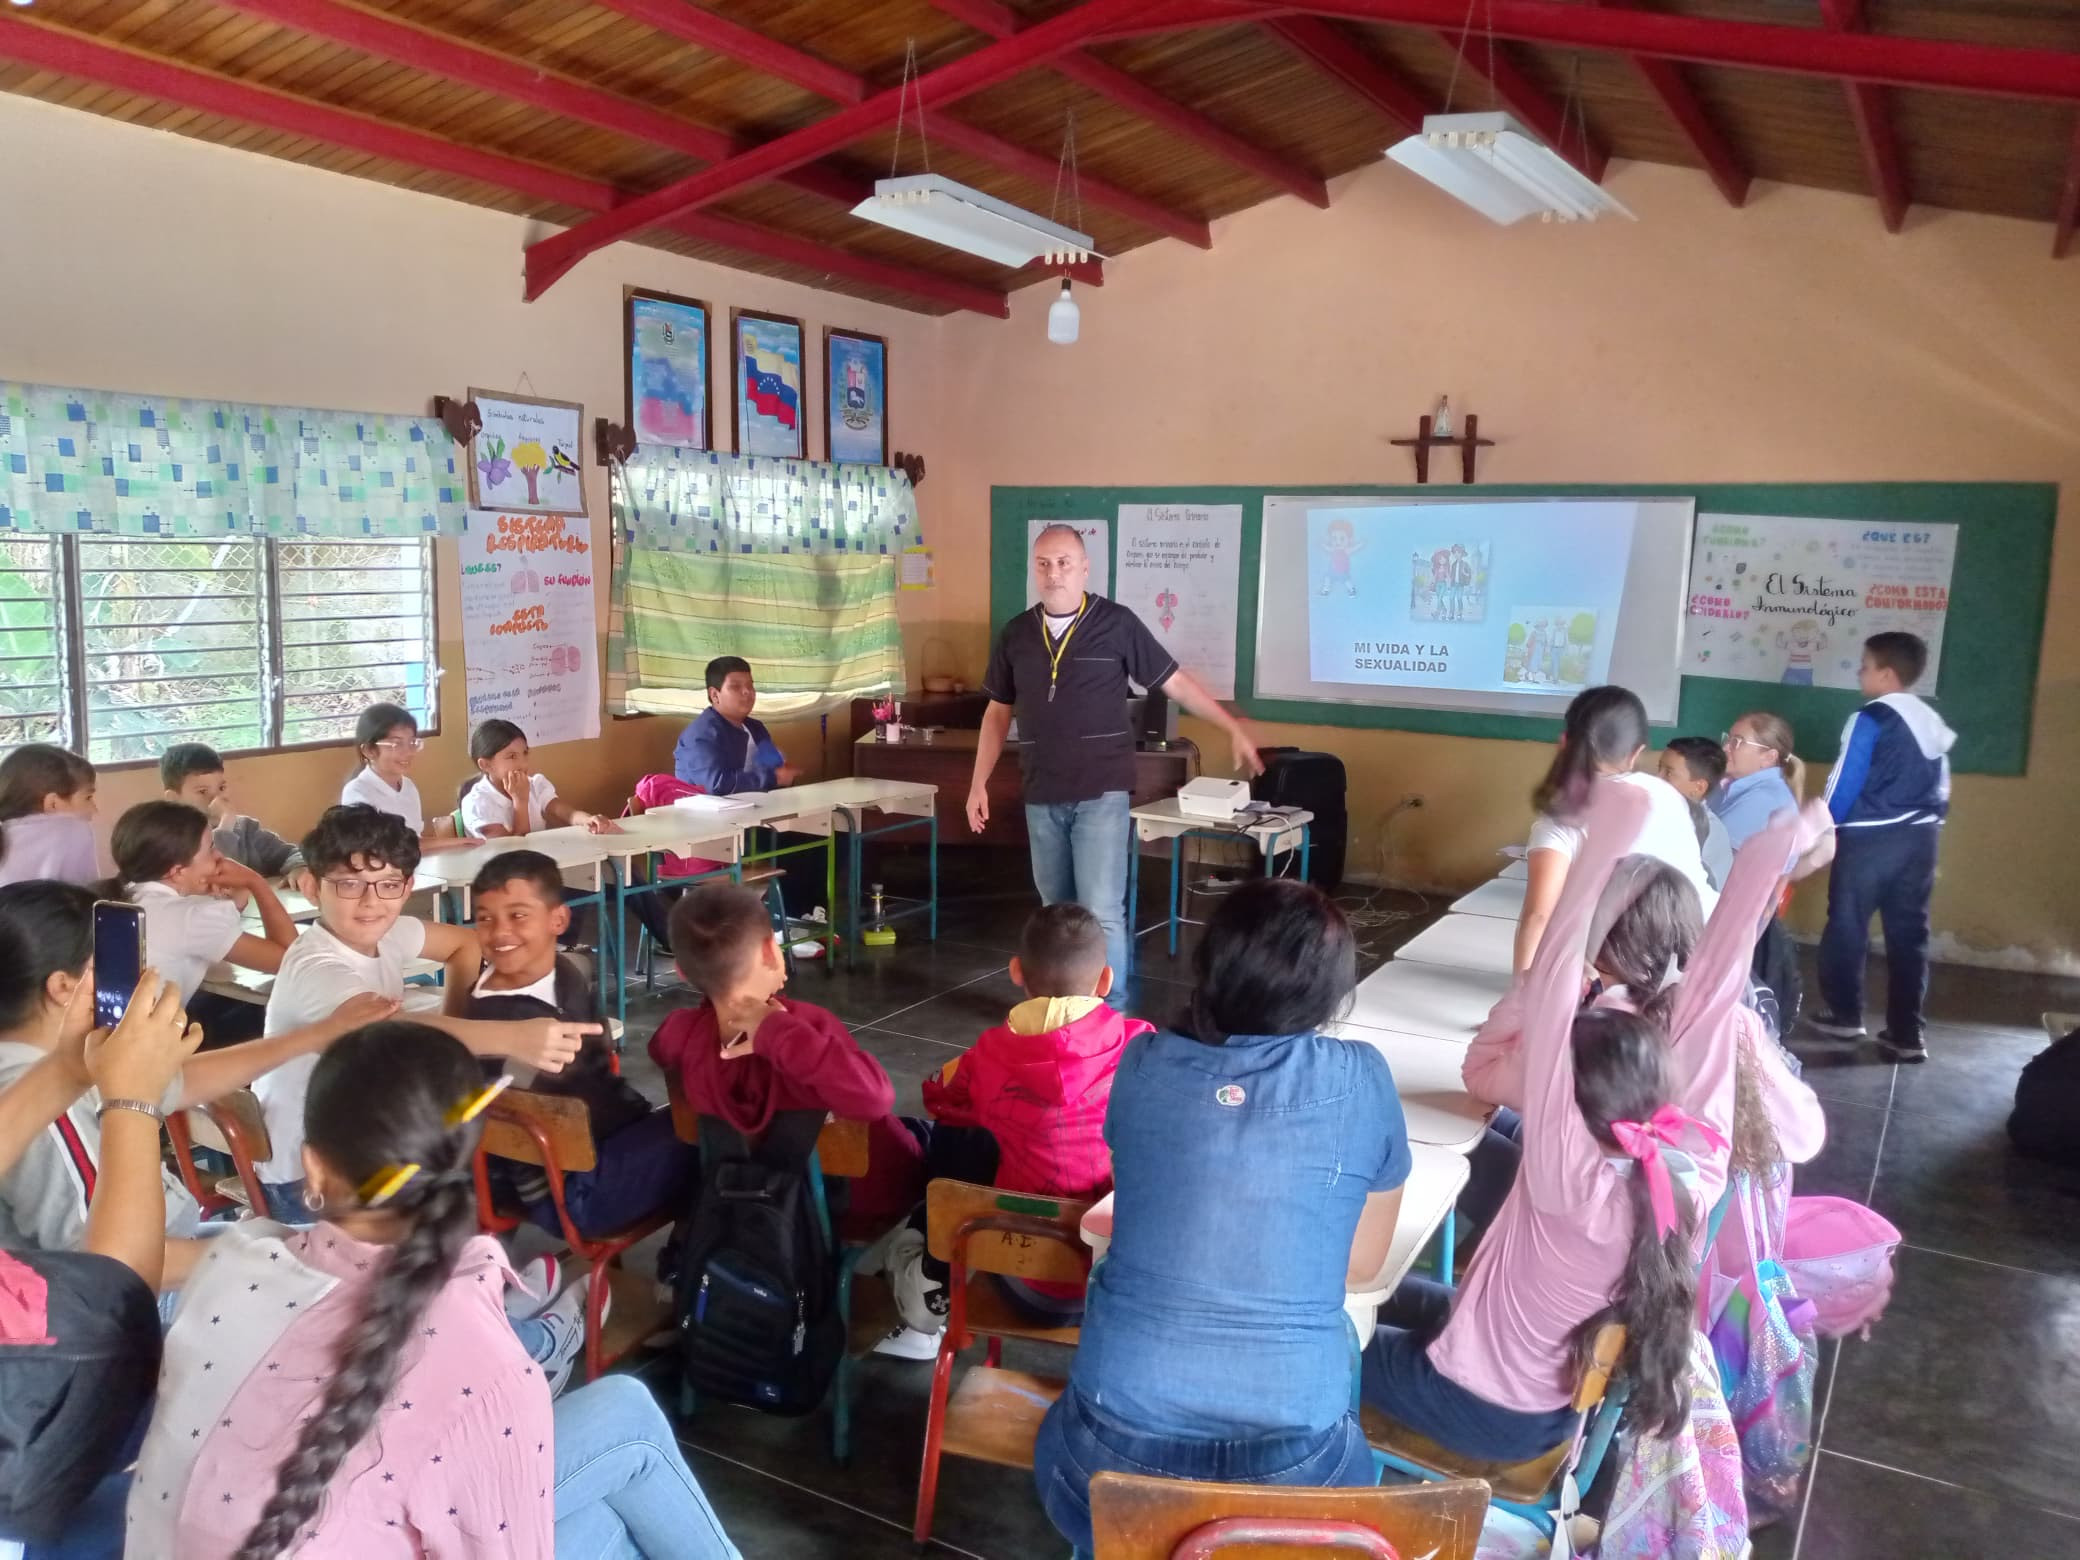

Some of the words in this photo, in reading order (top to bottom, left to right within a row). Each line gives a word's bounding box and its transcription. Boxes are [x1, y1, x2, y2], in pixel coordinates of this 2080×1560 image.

[1765, 571, 1785, 595] El
[1791, 573, 1858, 598] Sistema
[1751, 595, 1860, 627] Inmunológico
[1353, 642, 1371, 654] MI
[1375, 642, 1410, 656] VIDA
[1415, 644, 1425, 656] Y
[1430, 645, 1449, 657] LA
[1354, 658, 1448, 673] SEXUALIDAD
